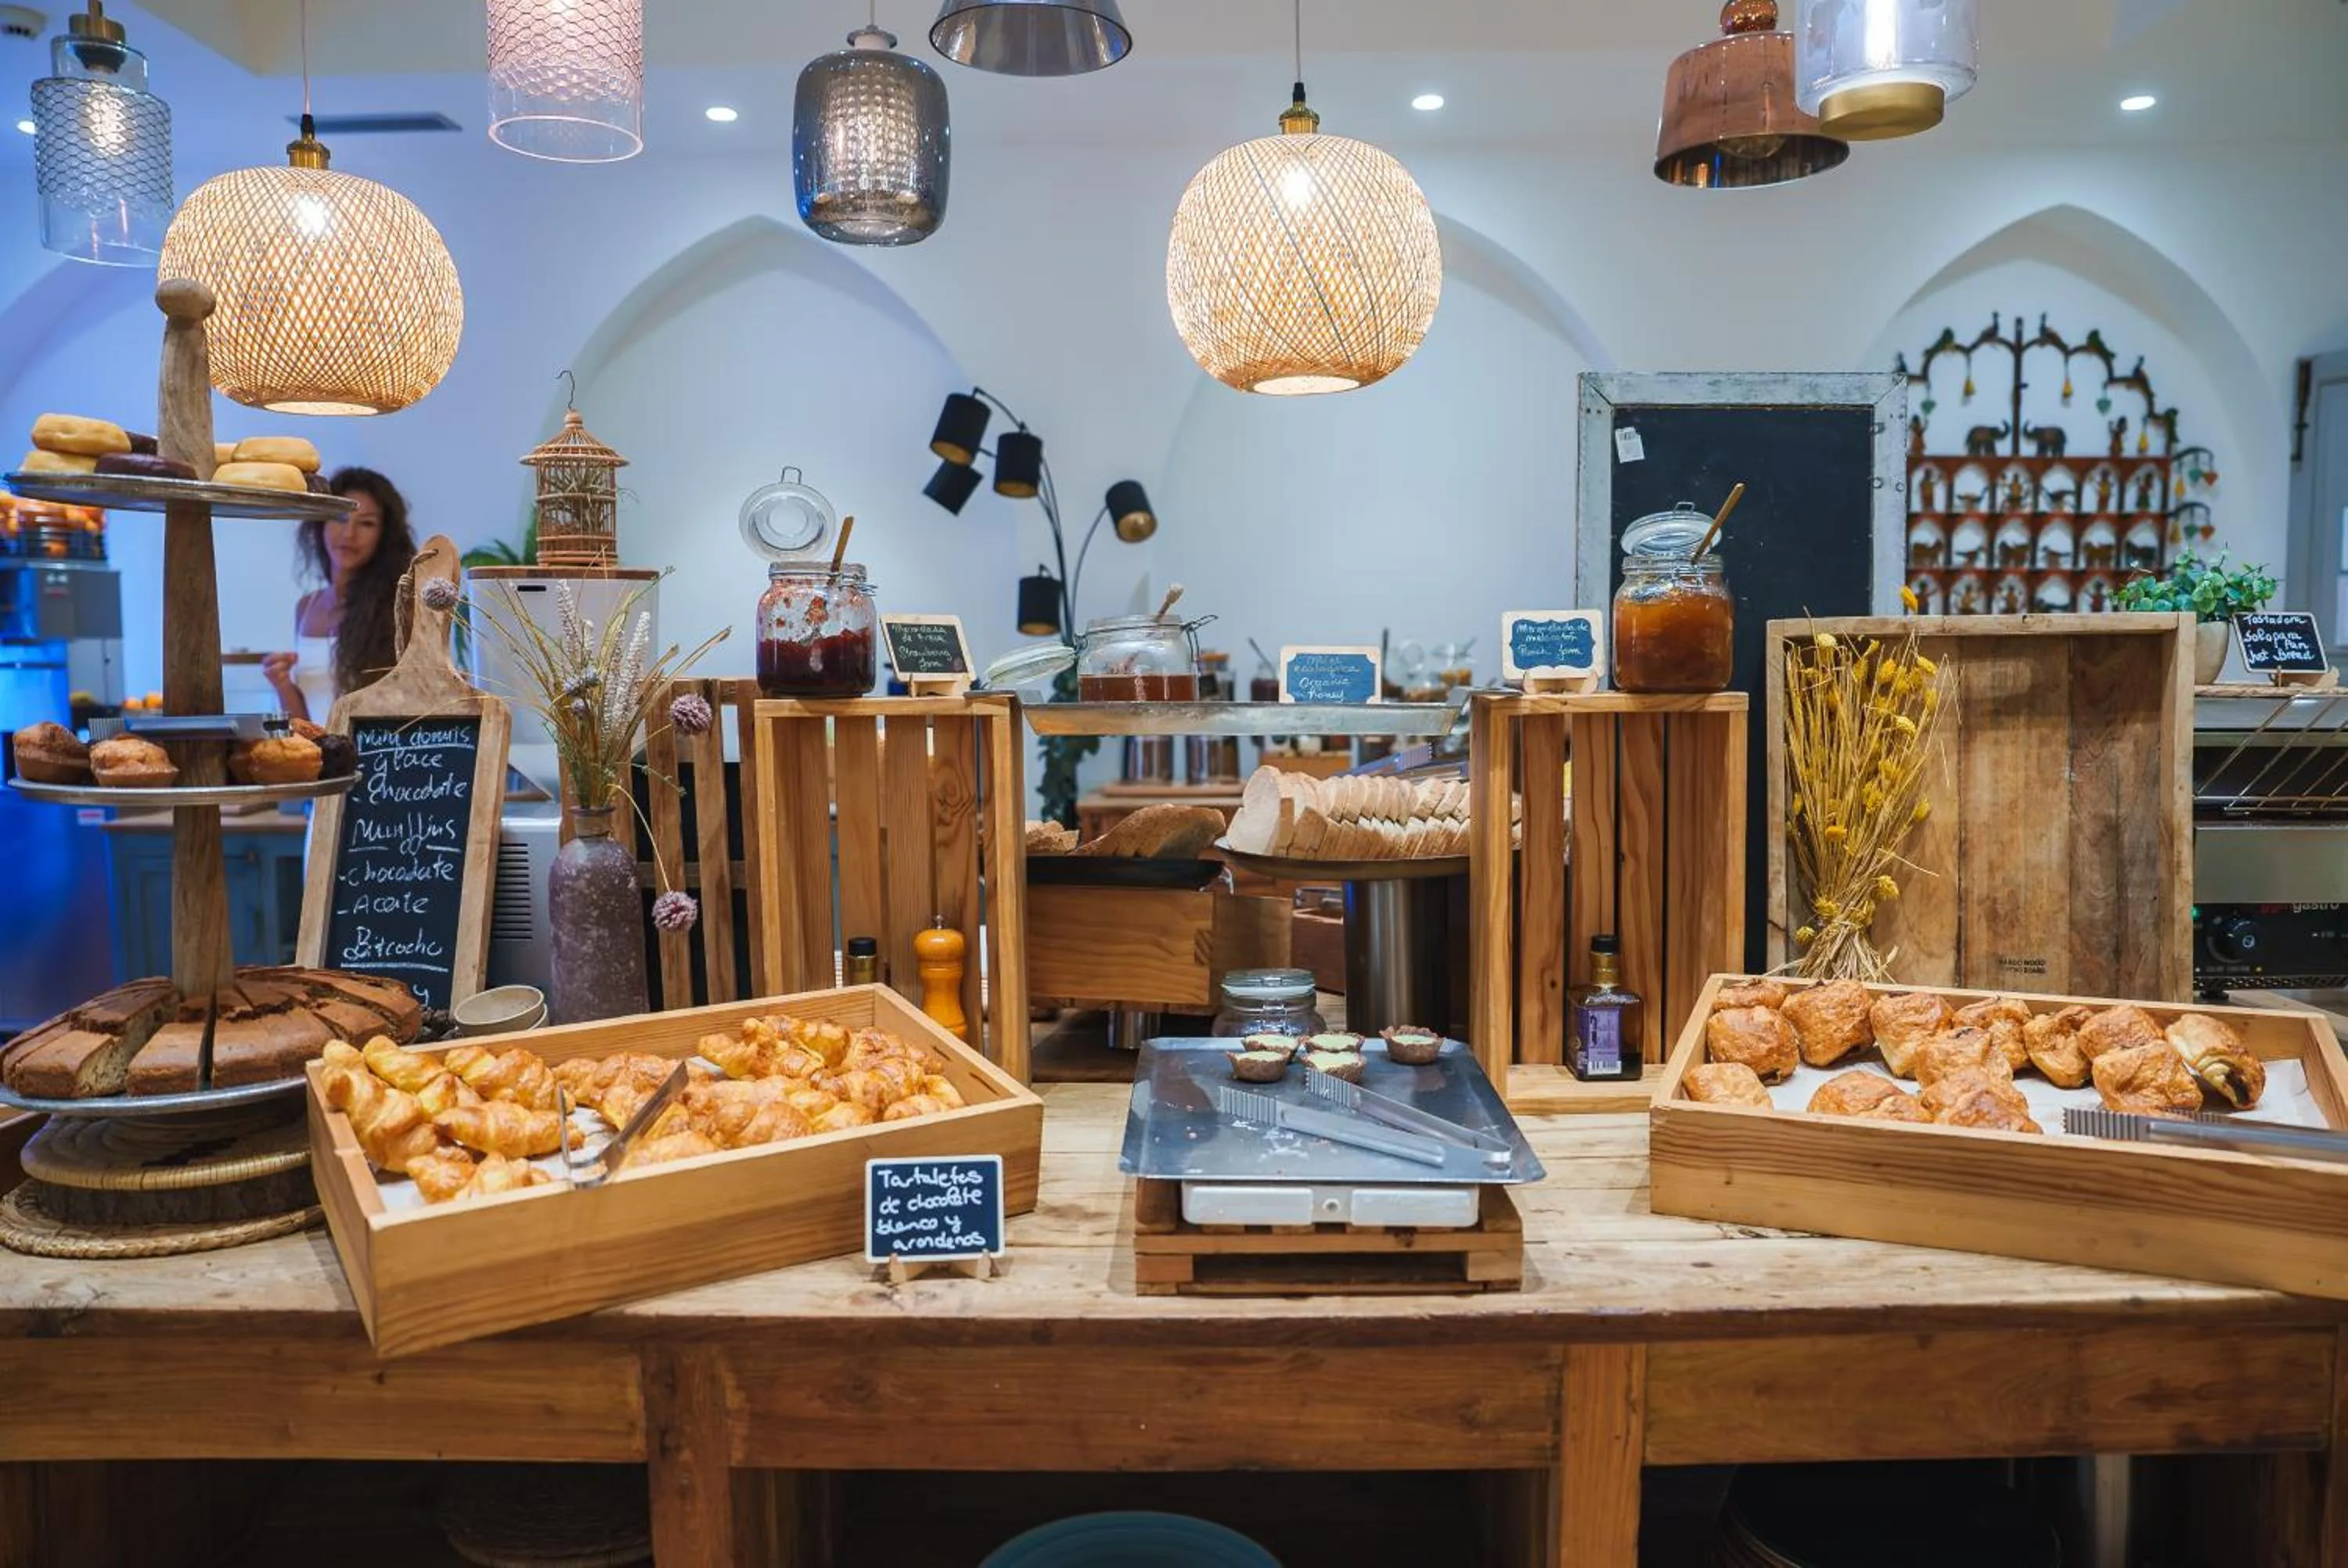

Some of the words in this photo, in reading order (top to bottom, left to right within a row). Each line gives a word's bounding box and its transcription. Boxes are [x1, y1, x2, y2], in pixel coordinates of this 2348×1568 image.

[2242, 613, 2307, 625] Tostadora
[879, 1196, 901, 1214] de
[944, 1214, 962, 1234] y
